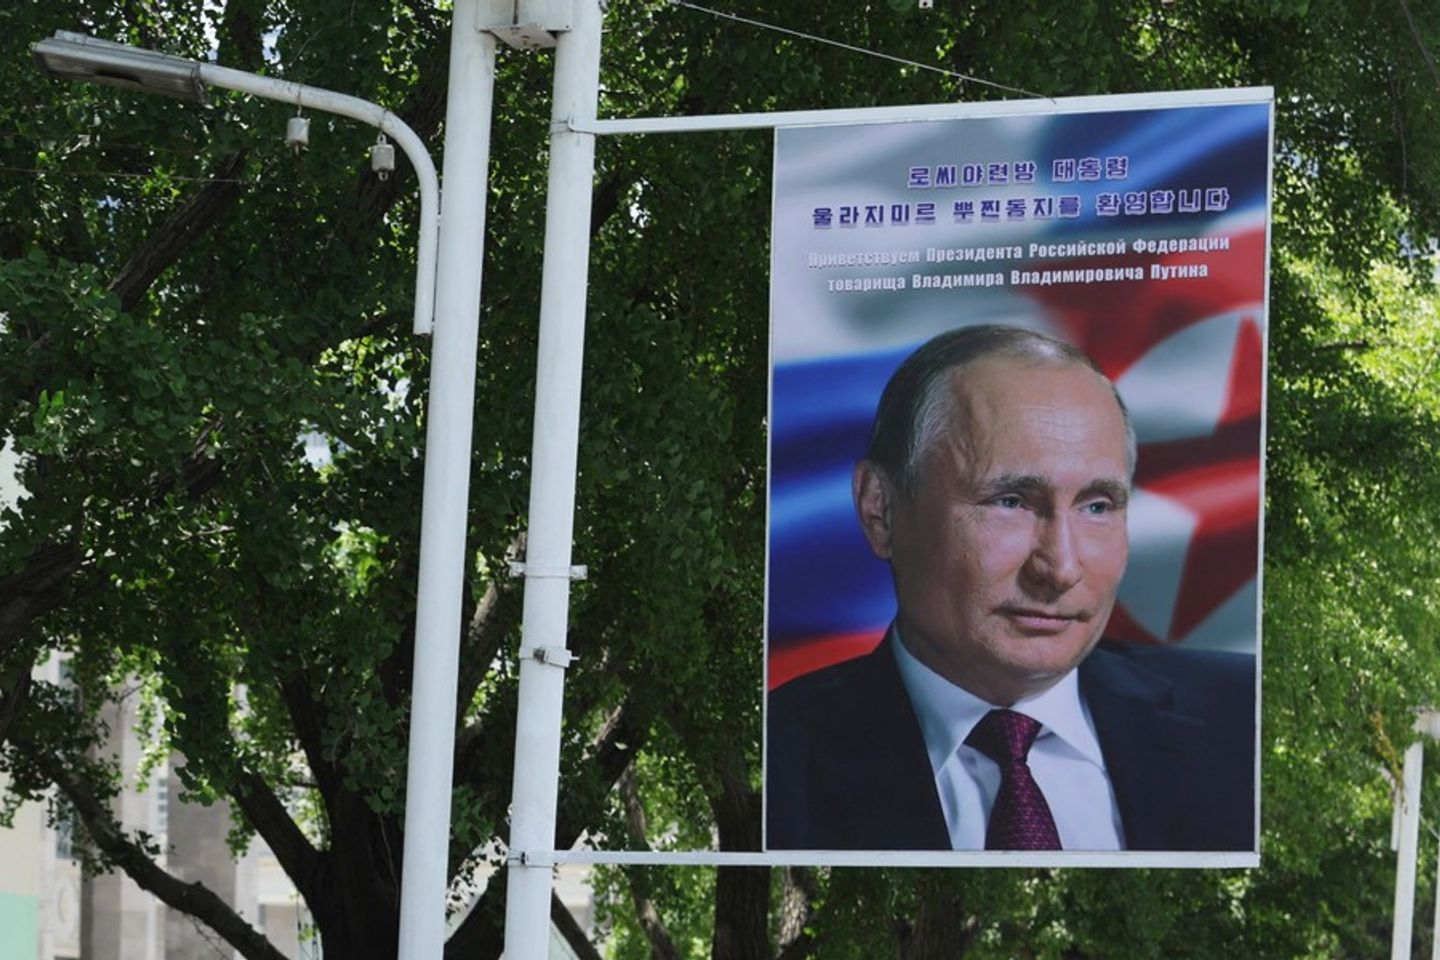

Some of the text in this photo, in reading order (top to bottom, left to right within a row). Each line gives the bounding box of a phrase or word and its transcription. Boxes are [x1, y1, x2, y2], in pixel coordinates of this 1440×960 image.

[908, 162, 1036, 188] 로씨야련방
[812, 187, 1229, 228] 울라지미르 뿌찐동지를 환영합니다
[808, 236, 1230, 269] Приветствуем Президента Российской Федерации
[827, 263, 1208, 292] товарища Владимира Владимировича Путина
